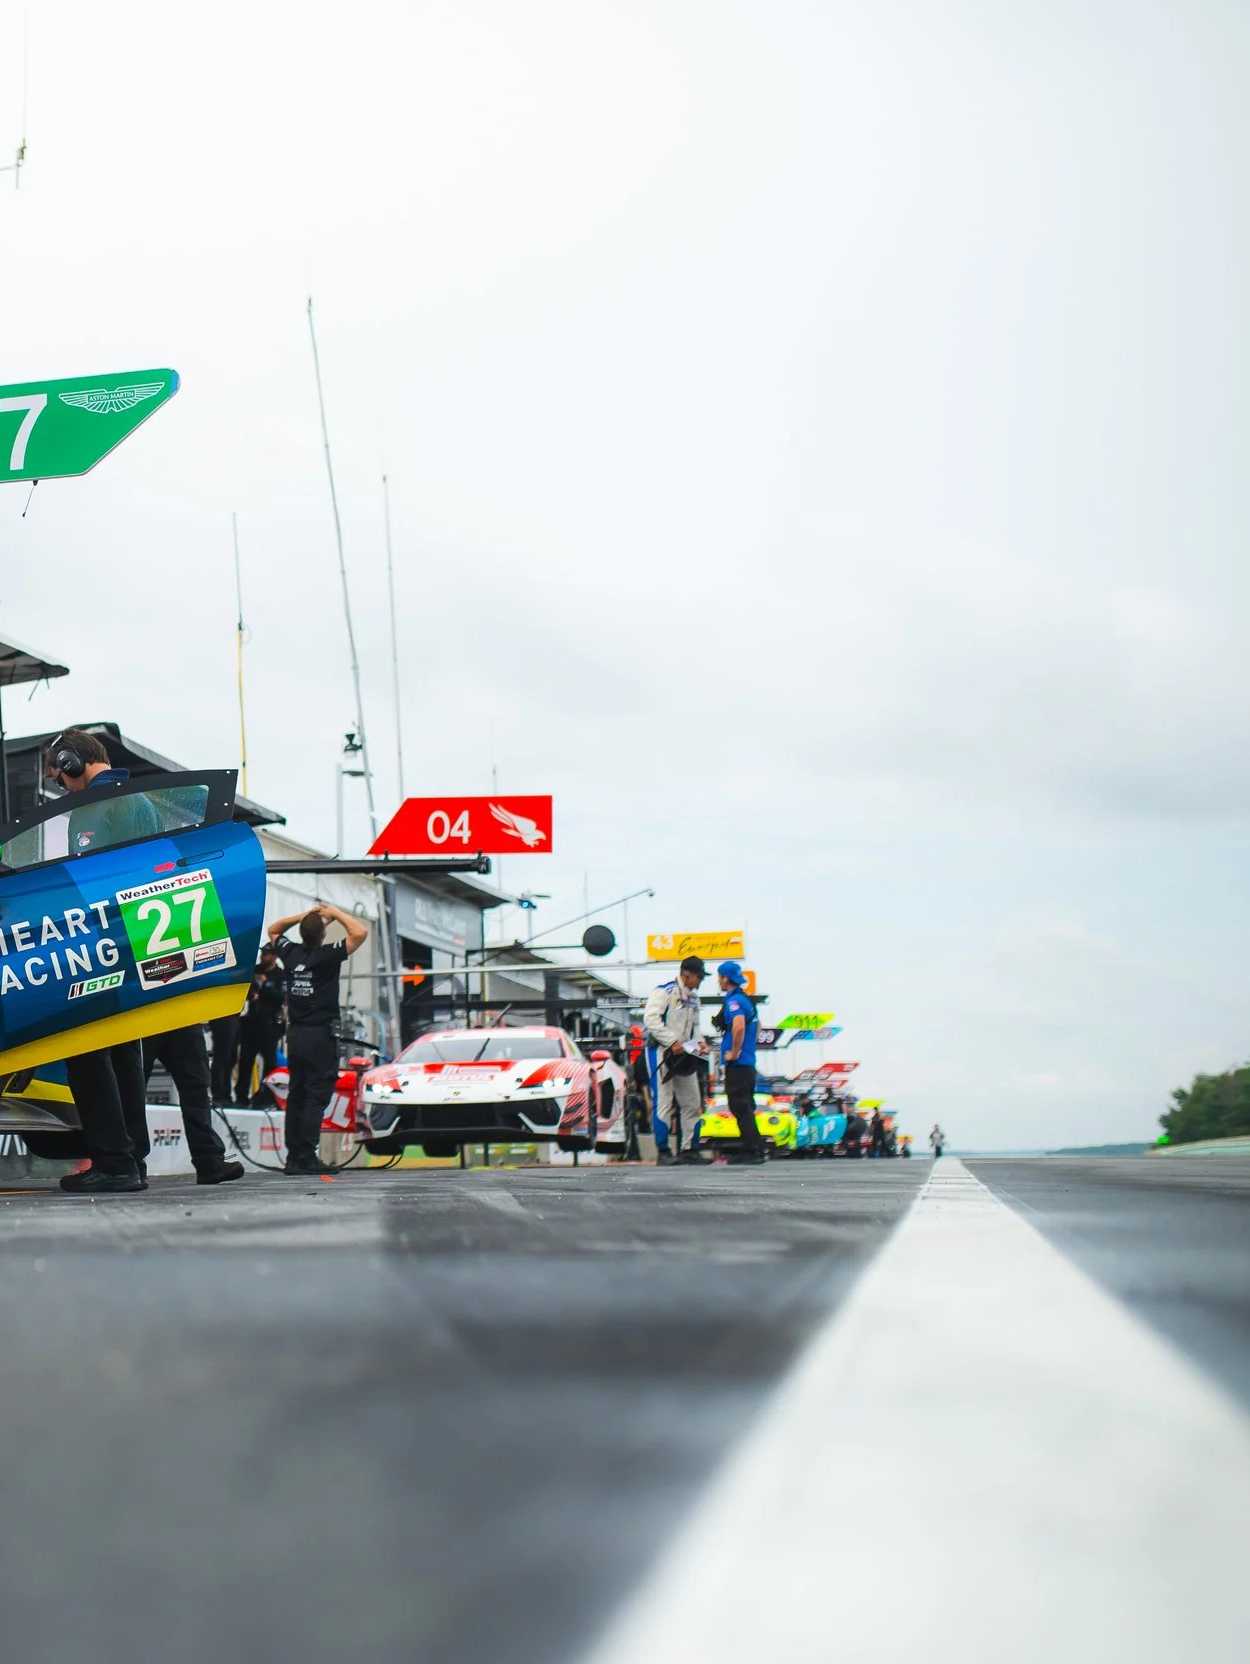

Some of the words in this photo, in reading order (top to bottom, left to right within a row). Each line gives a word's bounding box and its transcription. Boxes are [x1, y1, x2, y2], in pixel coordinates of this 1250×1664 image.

[89, 394, 110, 403] ASTON
[111, 390, 135, 400] MARTIN
[427, 810, 471, 844] 04
[120, 873, 208, 900] WeatherTech
[137, 887, 207, 956] 27
[652, 934, 674, 950] 43
[86, 975, 121, 992] GTD
[793, 1015, 820, 1029] 911
[757, 1030, 775, 1044] 99
